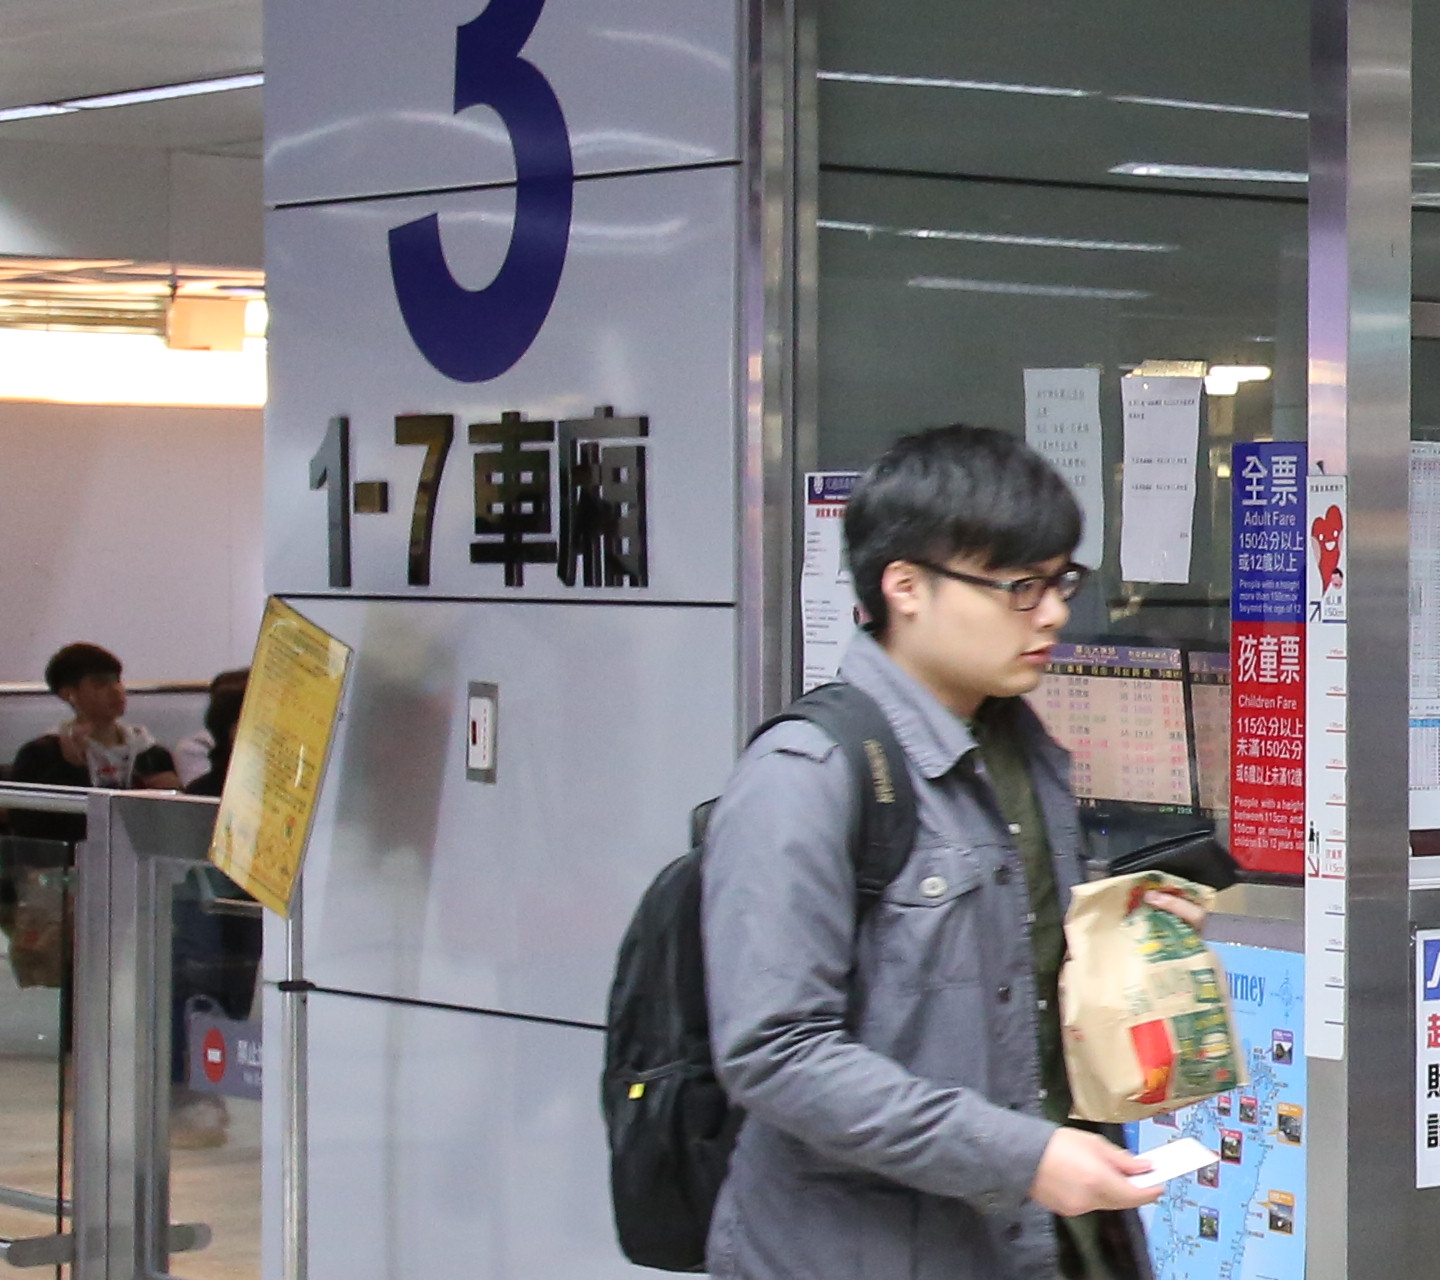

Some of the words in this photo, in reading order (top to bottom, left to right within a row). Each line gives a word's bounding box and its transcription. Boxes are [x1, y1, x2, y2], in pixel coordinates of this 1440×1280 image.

[1242, 456, 1298, 506] 全票
[1244, 511, 1271, 526] Adult
[1273, 512, 1296, 526] Fare
[1240, 531, 1304, 551] 150公分以上
[1238, 634, 1300, 683] 孩童票
[1238, 695, 1275, 708] Children
[1277, 697, 1297, 709] Fare
[1237, 717, 1303, 738] 115公分以上
[1237, 738, 1303, 759] 未滿150公分
